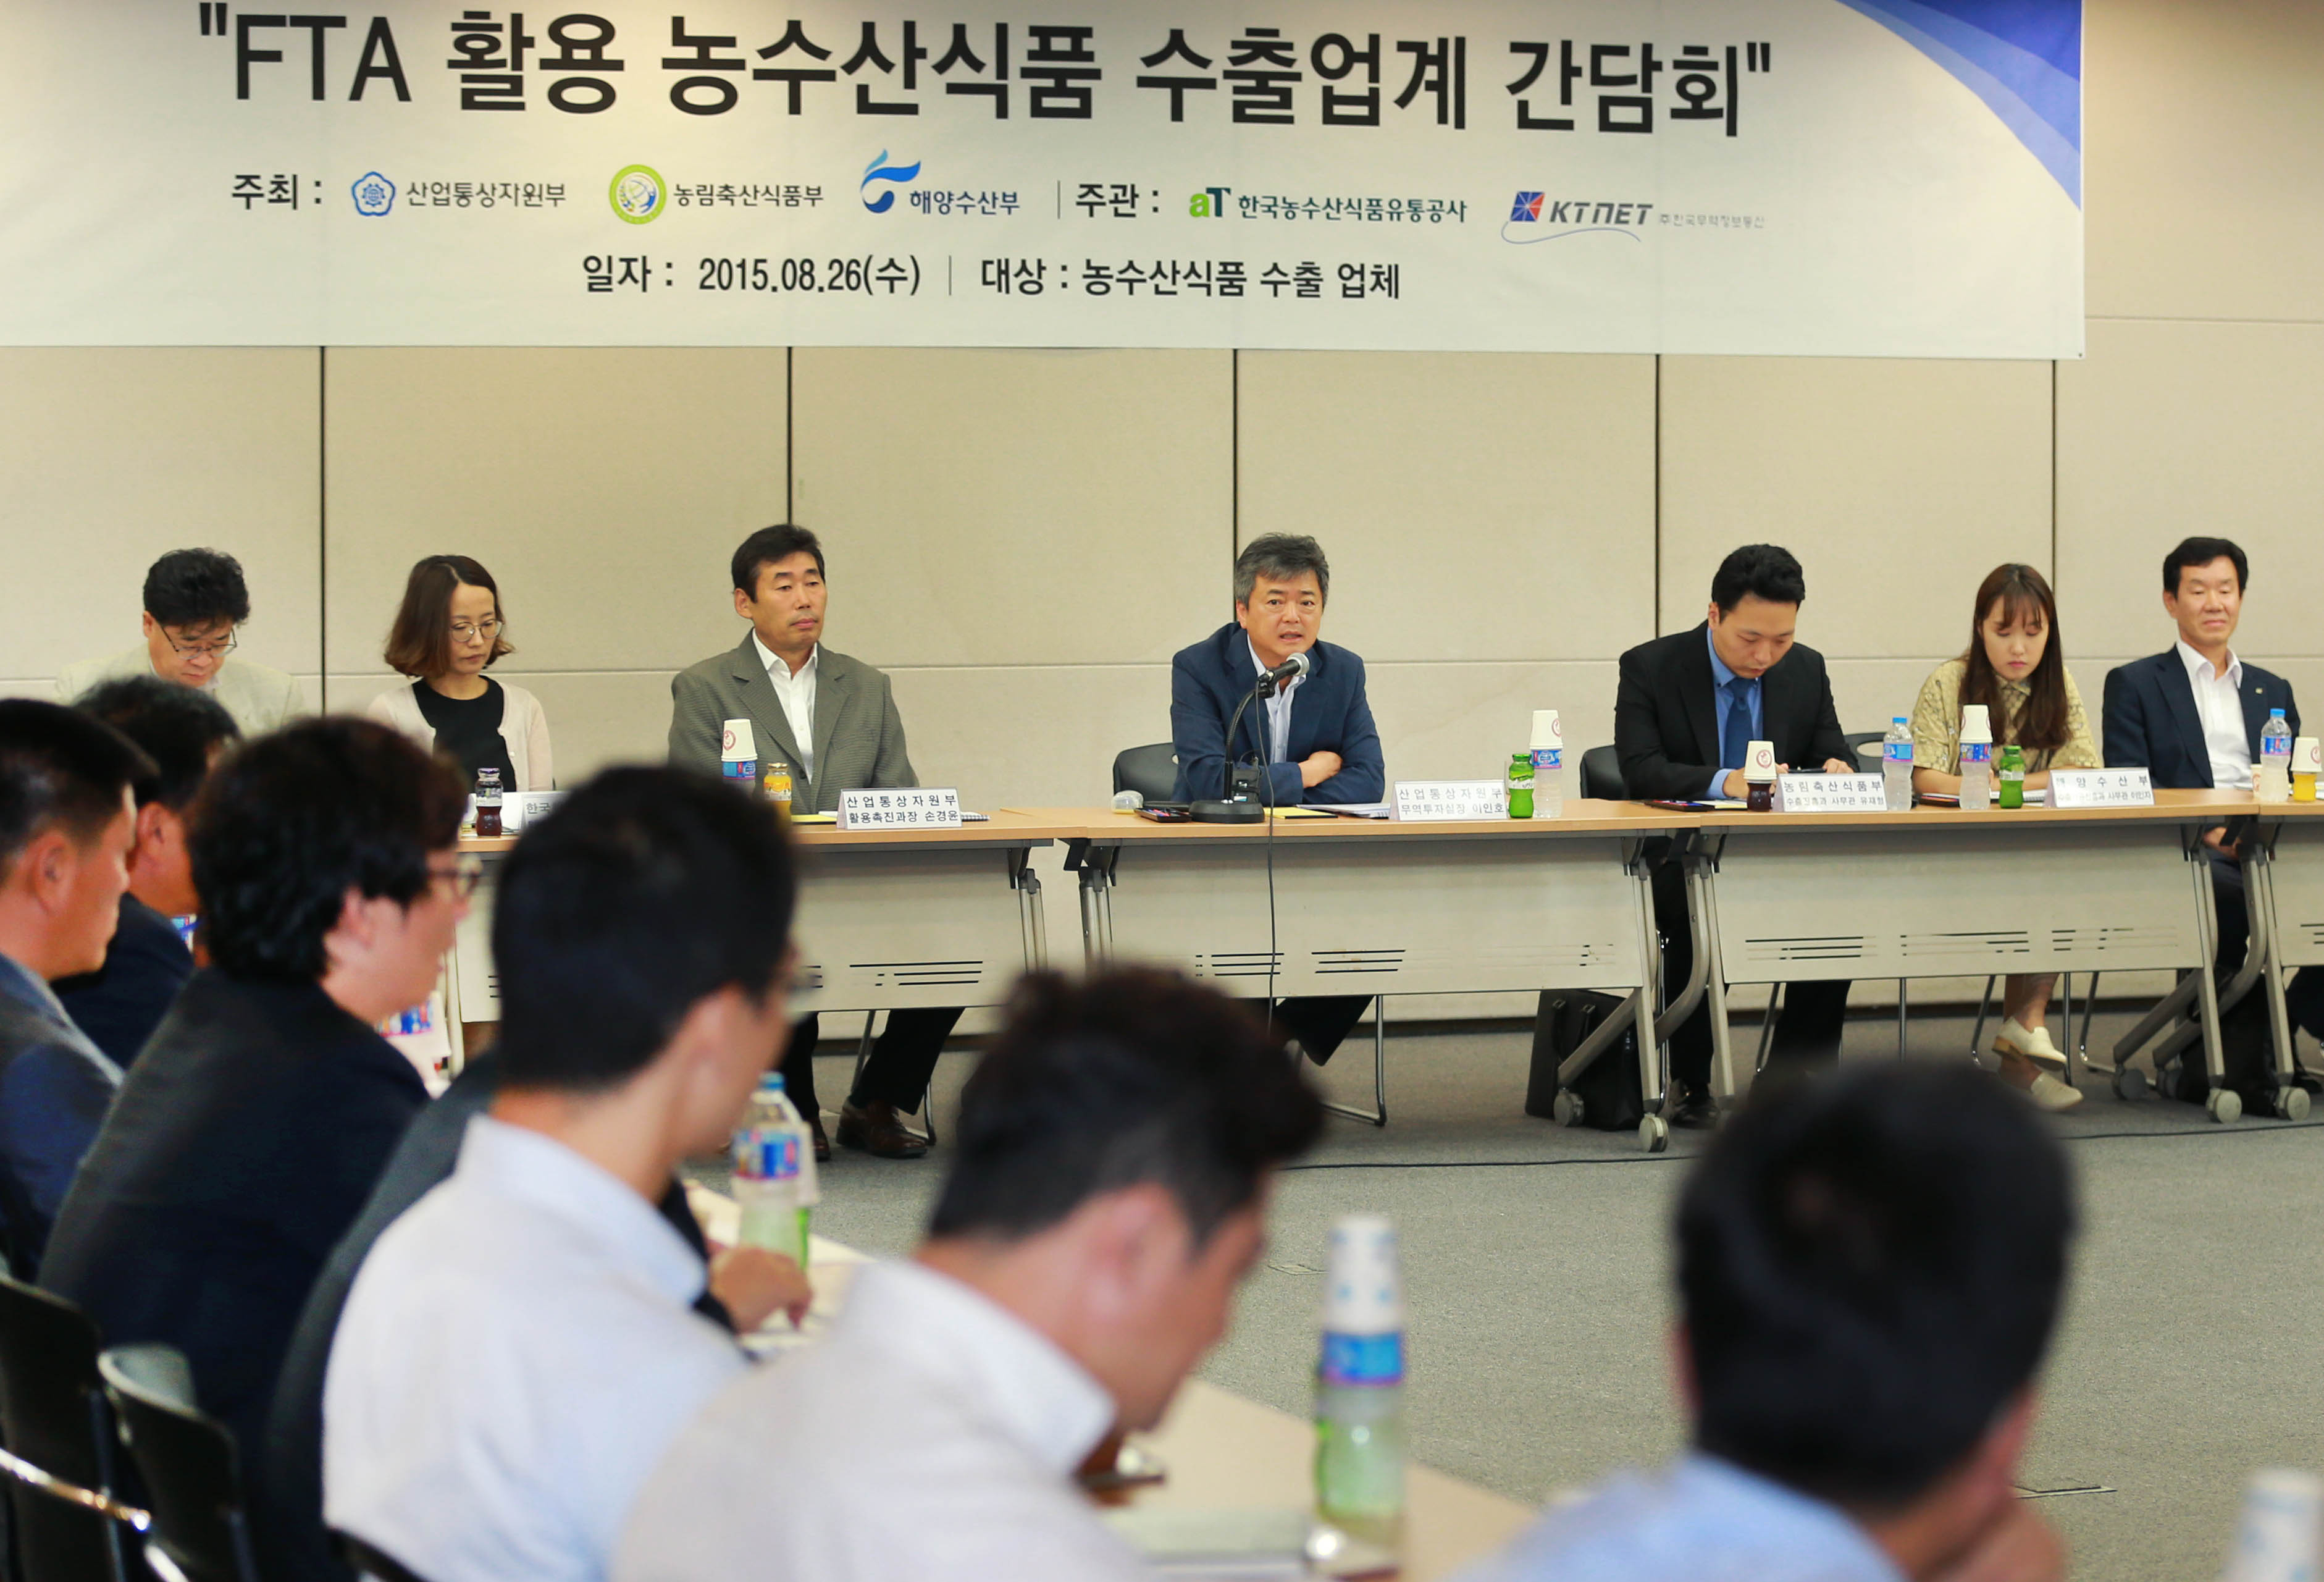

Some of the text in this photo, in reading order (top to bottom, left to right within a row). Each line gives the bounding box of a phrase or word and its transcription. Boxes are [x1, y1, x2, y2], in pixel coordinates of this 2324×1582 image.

[199, 2, 1771, 137] "FTA 활용 농수산식품 수출업계 간담회"
[232, 174, 298, 211] 주최
[406, 182, 566, 208] 산업통상자원부
[673, 183, 824, 208] 농림축산식품부
[910, 190, 1020, 216] 해양수산부
[1075, 183, 1139, 218] 주관
[1189, 187, 1231, 218] aT
[1238, 195, 1467, 224] 한국농수산식품유통공사
[1550, 201, 1653, 225] KTNET
[583, 255, 652, 293] 일자
[699, 254, 920, 296] 2015.08.26(수)
[981, 258, 1047, 295] 대상
[1082, 258, 1248, 297] 농수산식품
[1260, 261, 1324, 298] 수출
[1337, 263, 1399, 300] 업체
[1399, 788, 1503, 800] 산업통상자원부
[1784, 780, 1882, 793] 농림축산식품부
[847, 794, 957, 808] 산업통상자원부
[1472, 802, 1504, 814] 이인호
[849, 810, 959, 823] 활용촉진과장 손경윤
